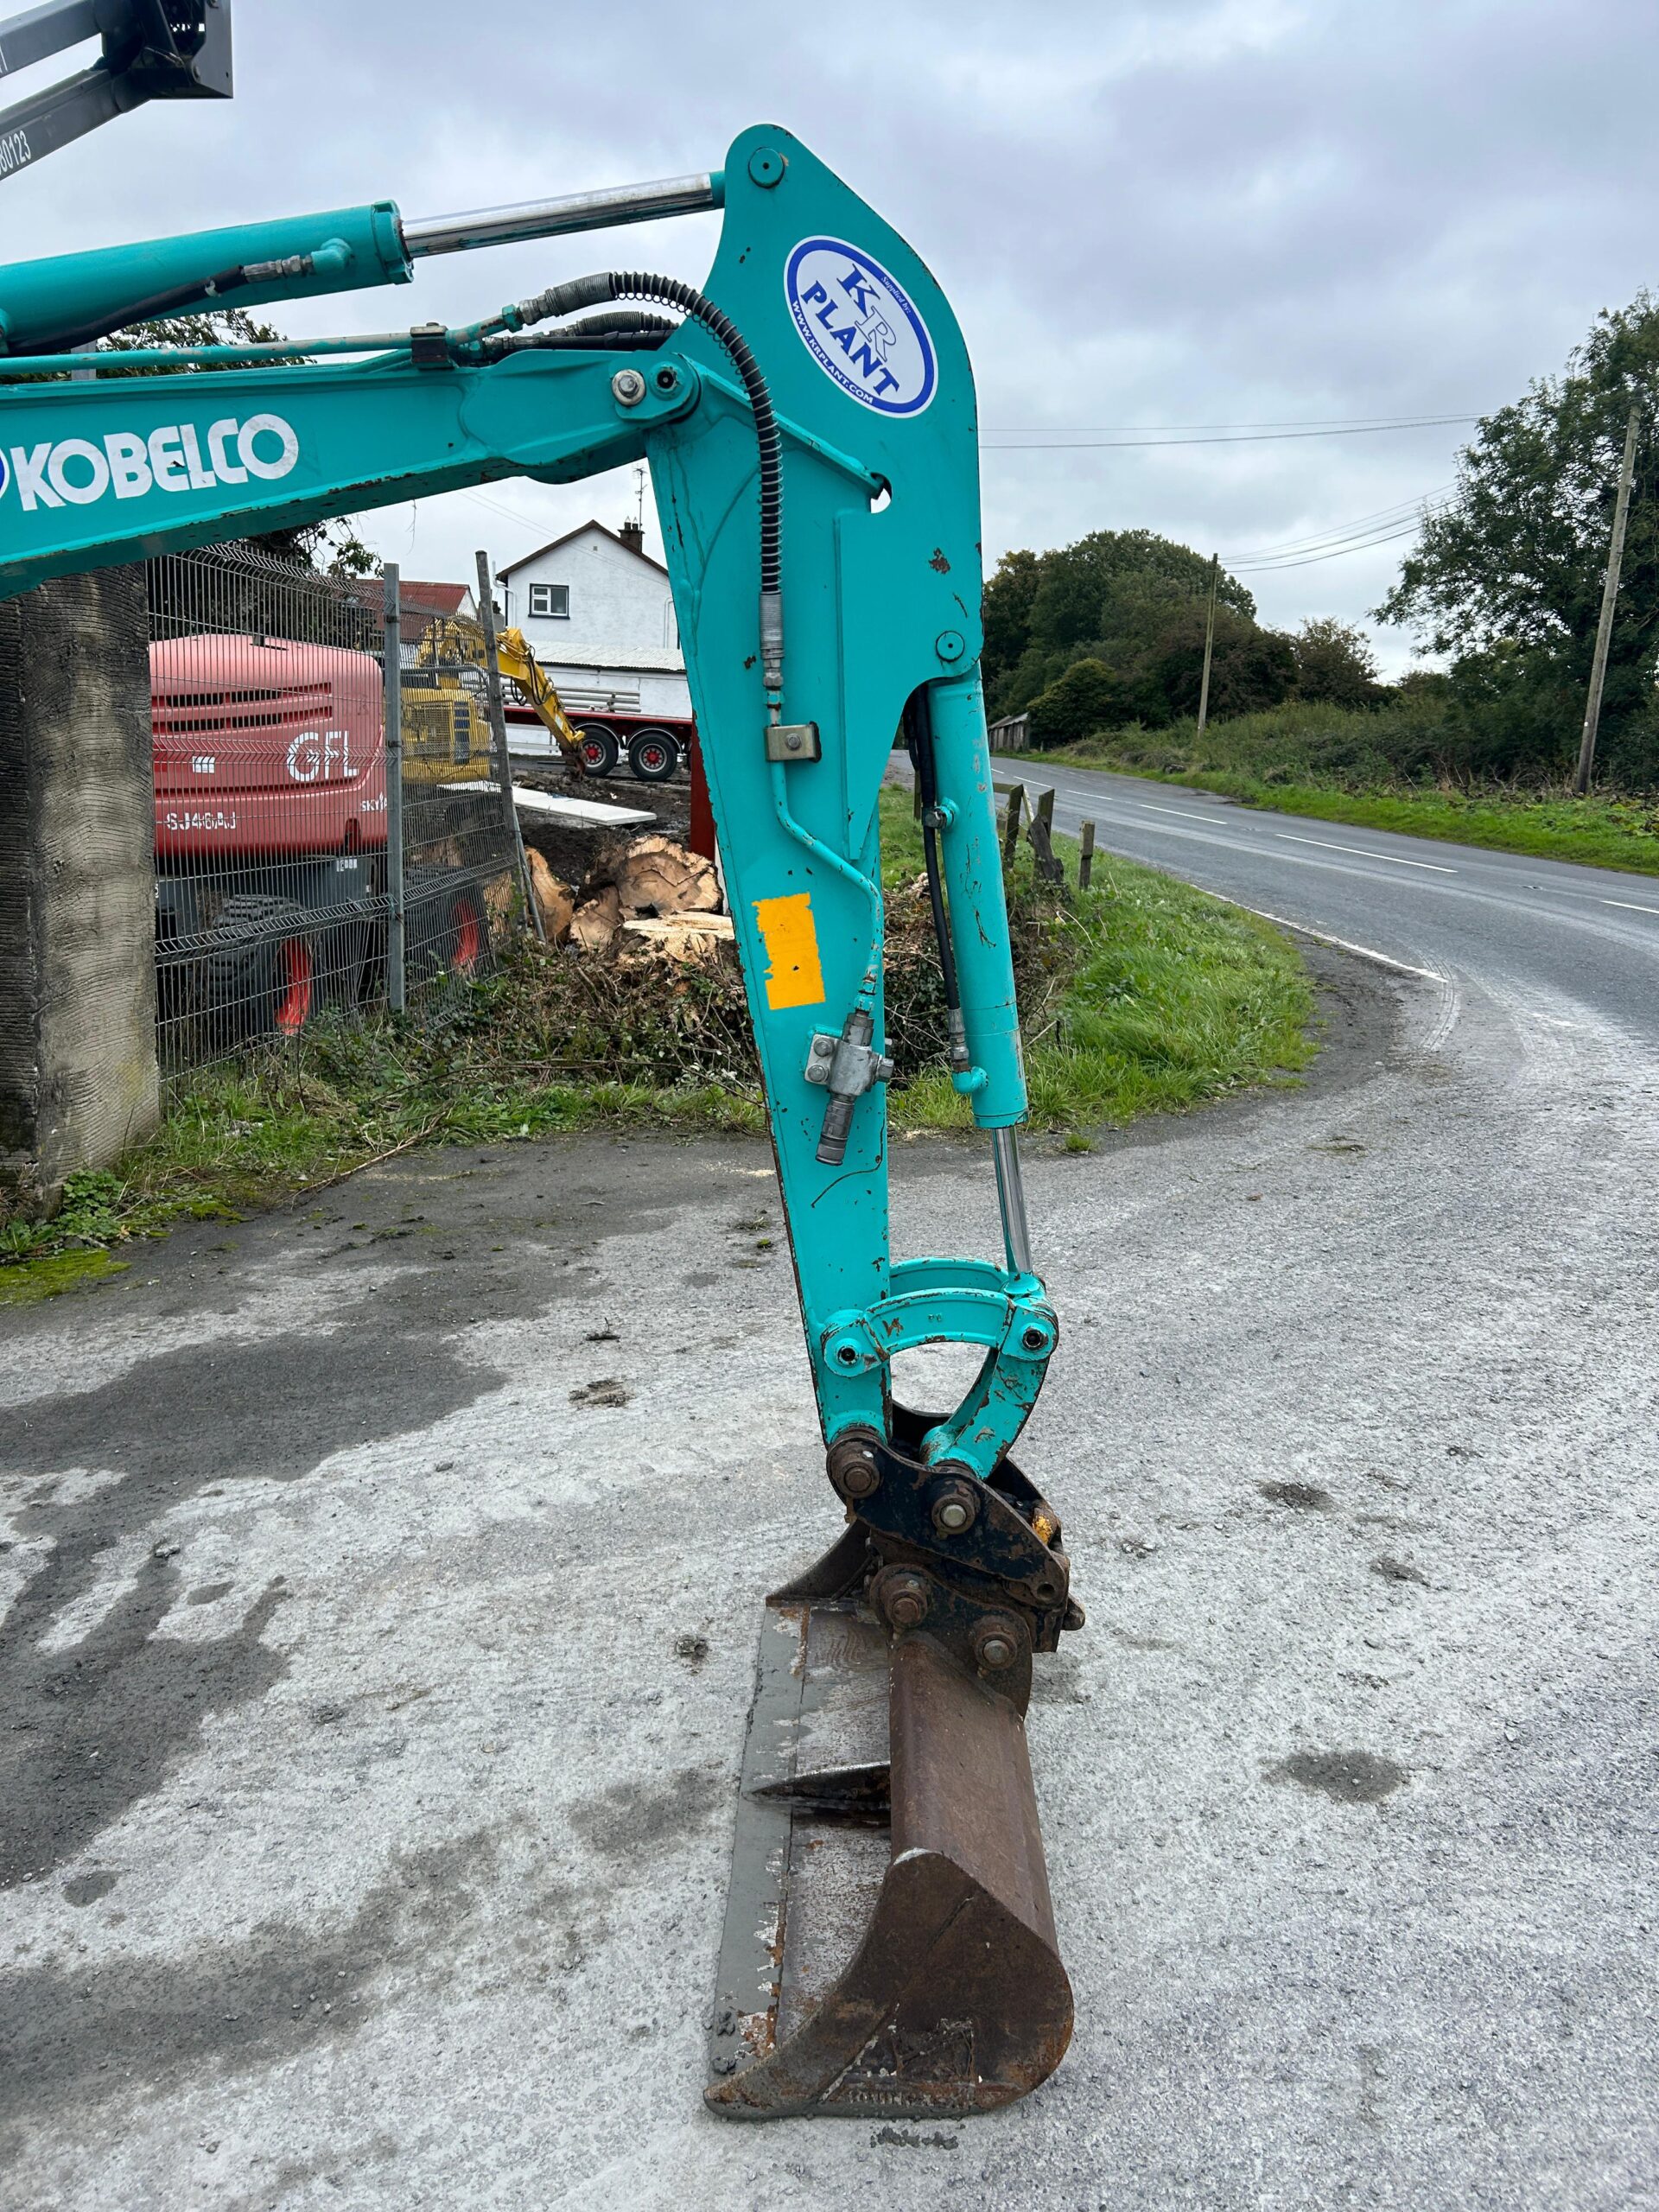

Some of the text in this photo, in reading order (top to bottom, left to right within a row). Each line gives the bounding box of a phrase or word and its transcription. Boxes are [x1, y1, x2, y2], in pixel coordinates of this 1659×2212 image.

[791, 300, 874, 404] WWW.KRPLANT.COM
[800, 280, 900, 397] PLANT
[10, 413, 299, 512] KOBELCO
[286, 730, 359, 782] GFL
